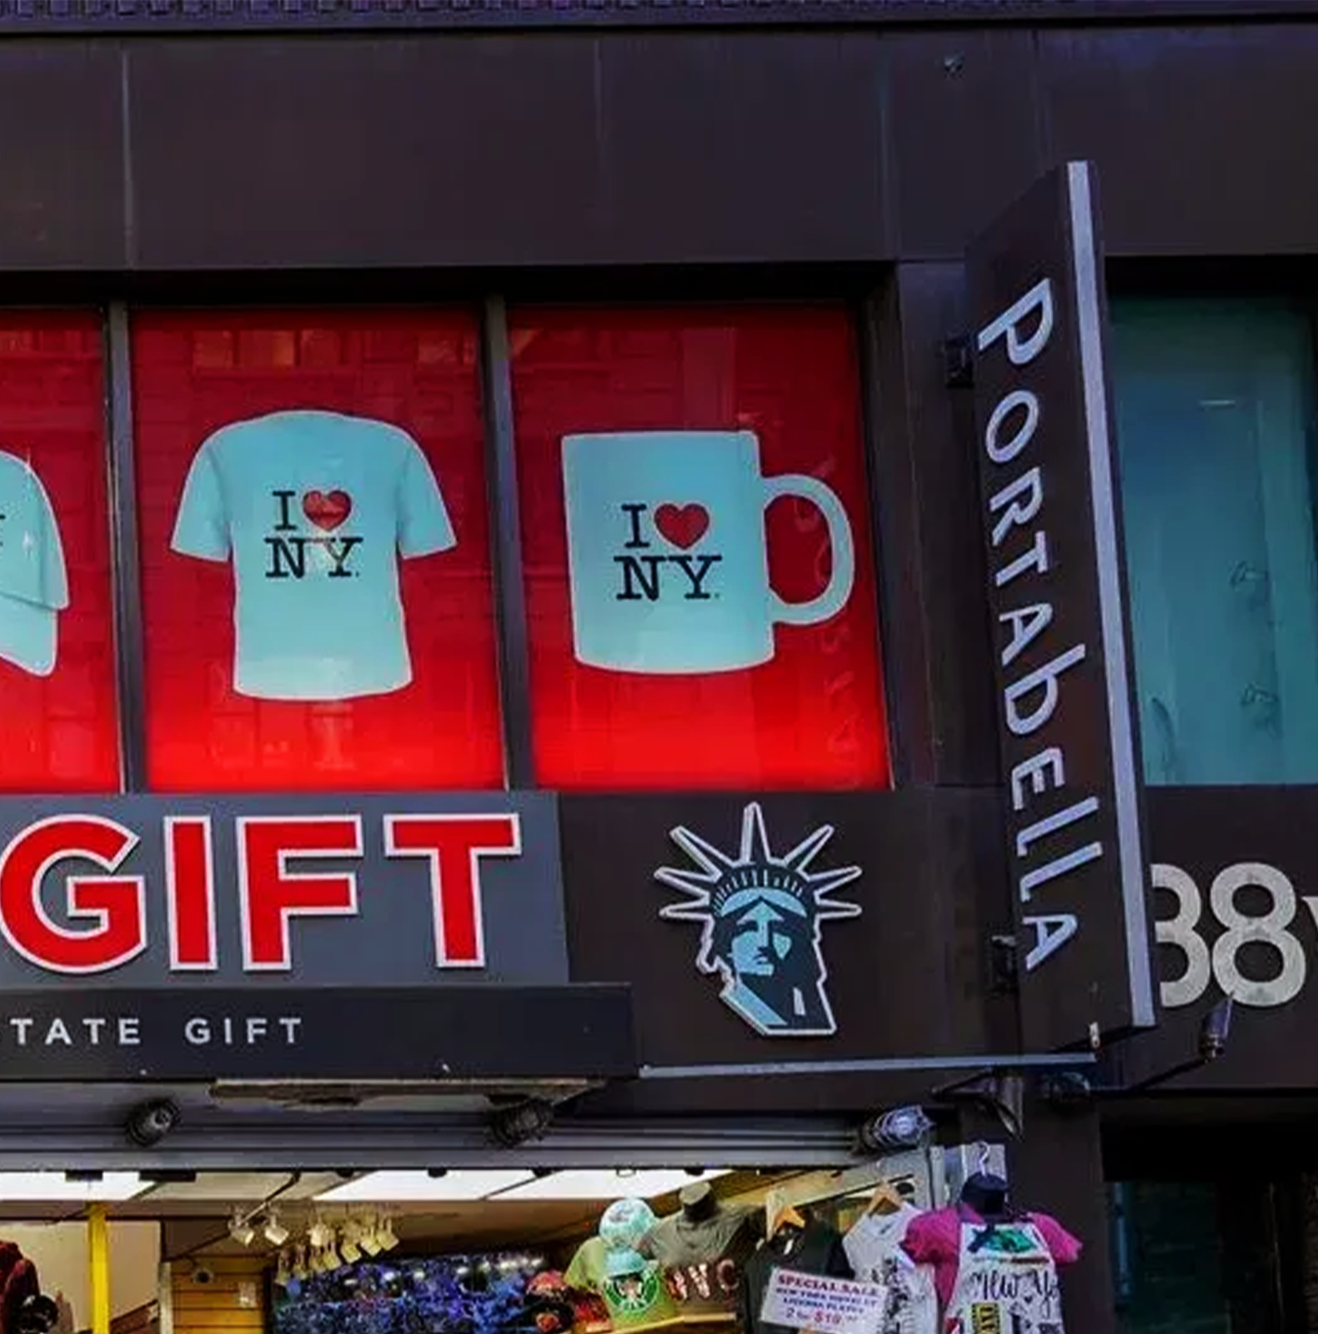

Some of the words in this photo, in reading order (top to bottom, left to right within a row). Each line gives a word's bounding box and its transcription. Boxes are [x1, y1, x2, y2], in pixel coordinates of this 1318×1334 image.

[272, 490, 297, 532] I
[621, 503, 649, 550] I
[184, 1016, 304, 1045] GIFT
[777, 1273, 836, 1293] SPECIAL
